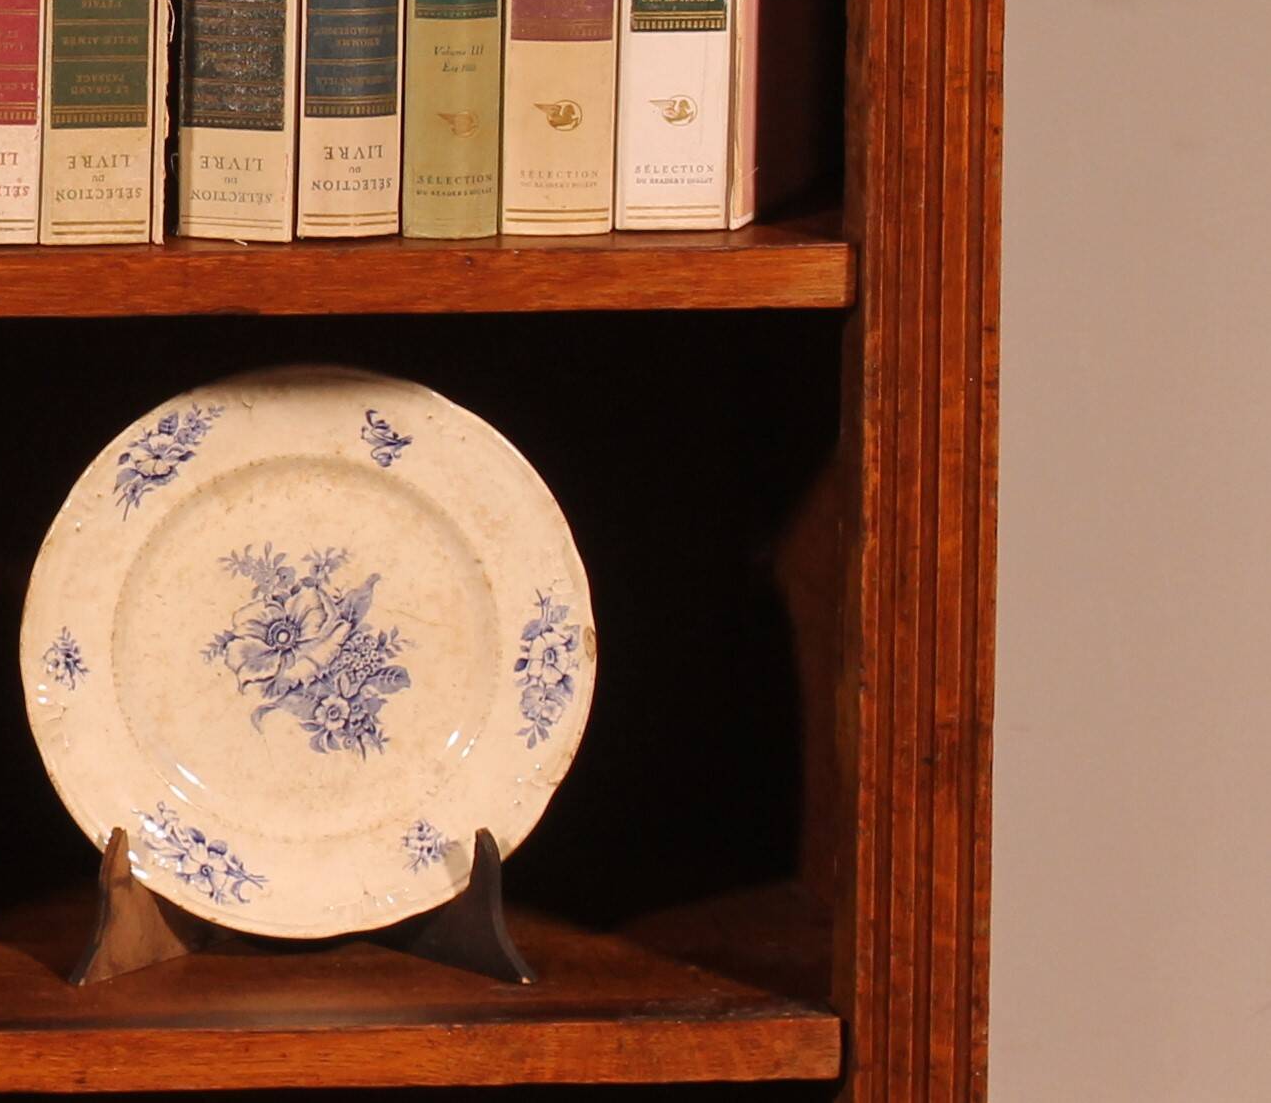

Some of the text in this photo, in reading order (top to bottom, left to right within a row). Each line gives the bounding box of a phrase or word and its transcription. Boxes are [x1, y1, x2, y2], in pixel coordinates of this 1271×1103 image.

[322, 144, 384, 161] LIVRE
[67, 153, 131, 170] LIVRE
[199, 154, 264, 172] LIVRE
[348, 165, 362, 174] DU
[634, 161, 714, 174] SÉLECTION
[91, 174, 105, 183] DU
[224, 177, 238, 185] DU
[519, 169, 599, 179] SÉLECTION
[311, 177, 393, 195] SÉLECTION
[55, 187, 144, 203] SÉLECTION
[190, 188, 275, 205] SÉLECTION
